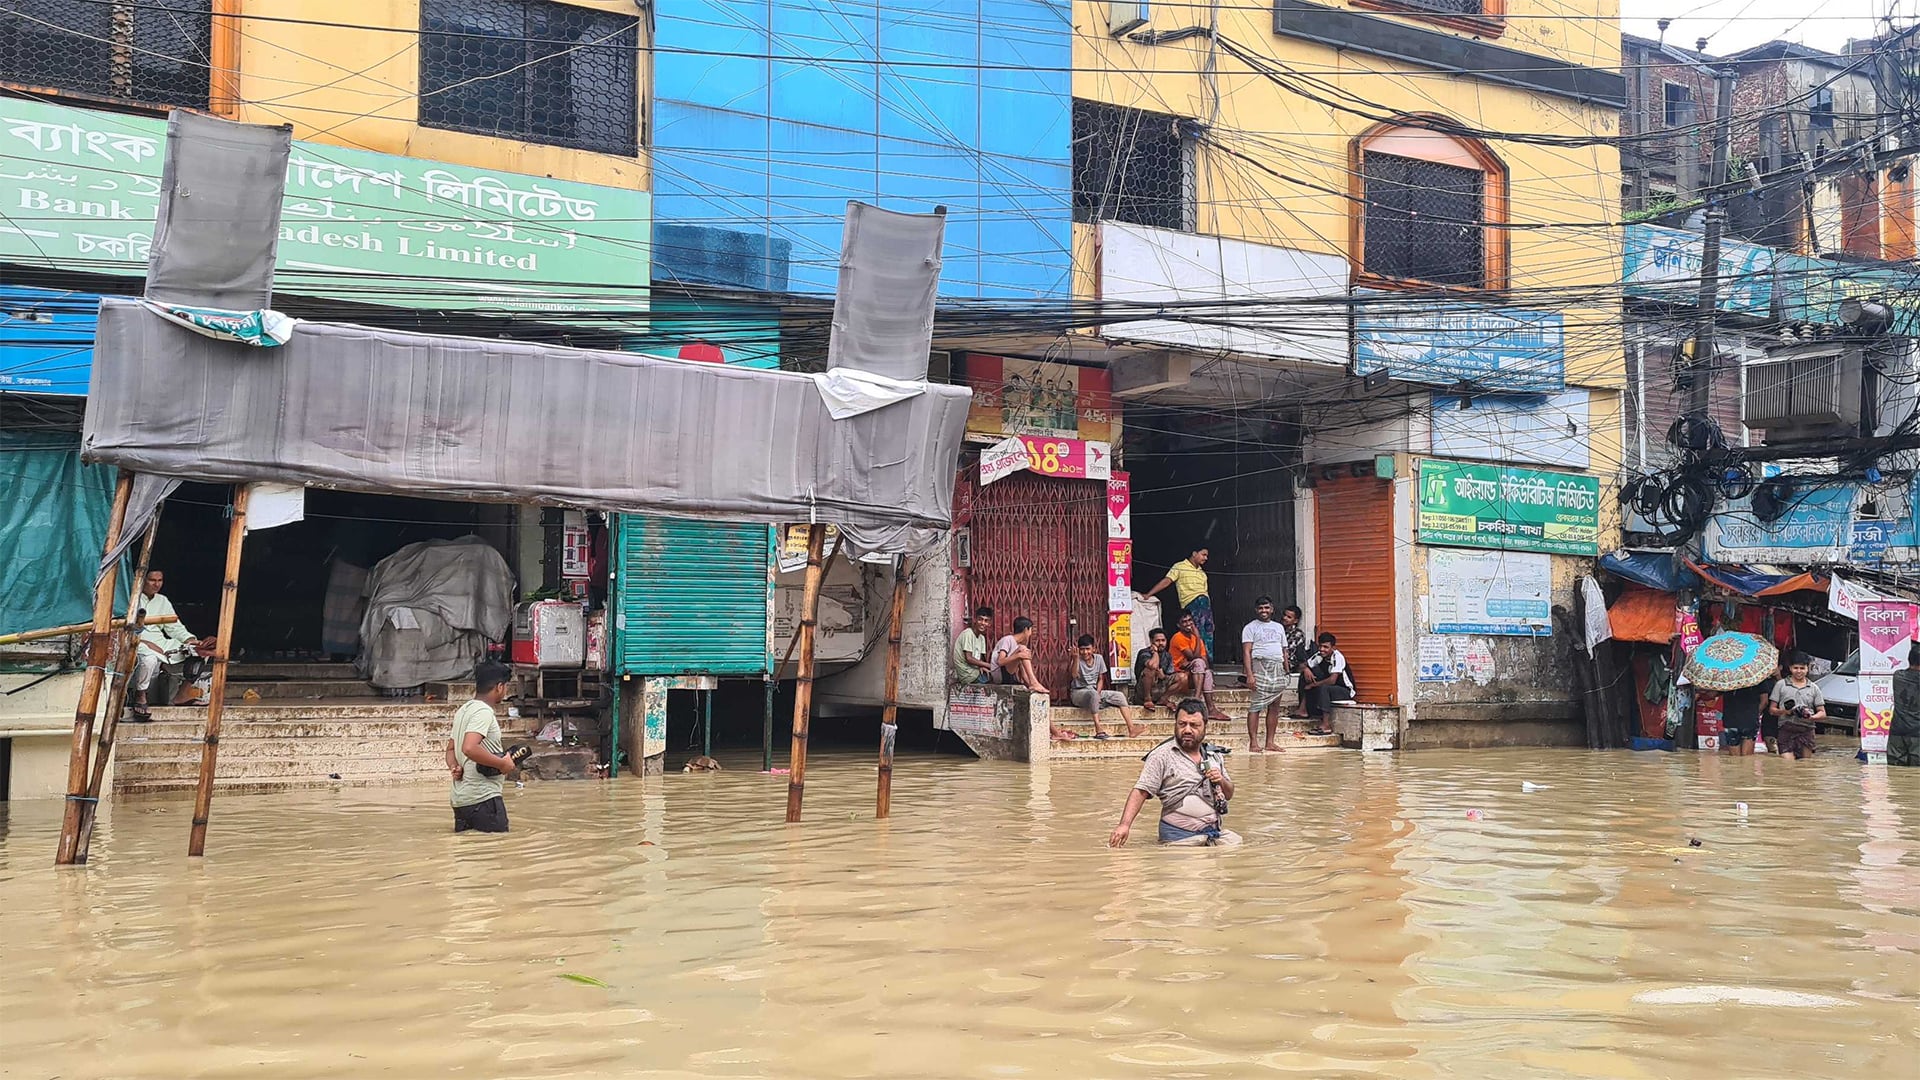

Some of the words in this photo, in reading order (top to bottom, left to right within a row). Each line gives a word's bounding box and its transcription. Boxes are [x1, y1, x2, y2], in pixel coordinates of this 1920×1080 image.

[2, 116, 159, 163] ব্যাংক
[419, 168, 600, 222] লিমিটেড
[18, 187, 136, 220] Bank
[279, 223, 385, 254] adesh
[397, 235, 538, 272] Limited
[73, 232, 152, 260] চকরি
[1863, 605, 1907, 622] বিকাশ
[1870, 626, 1900, 635] করুন
